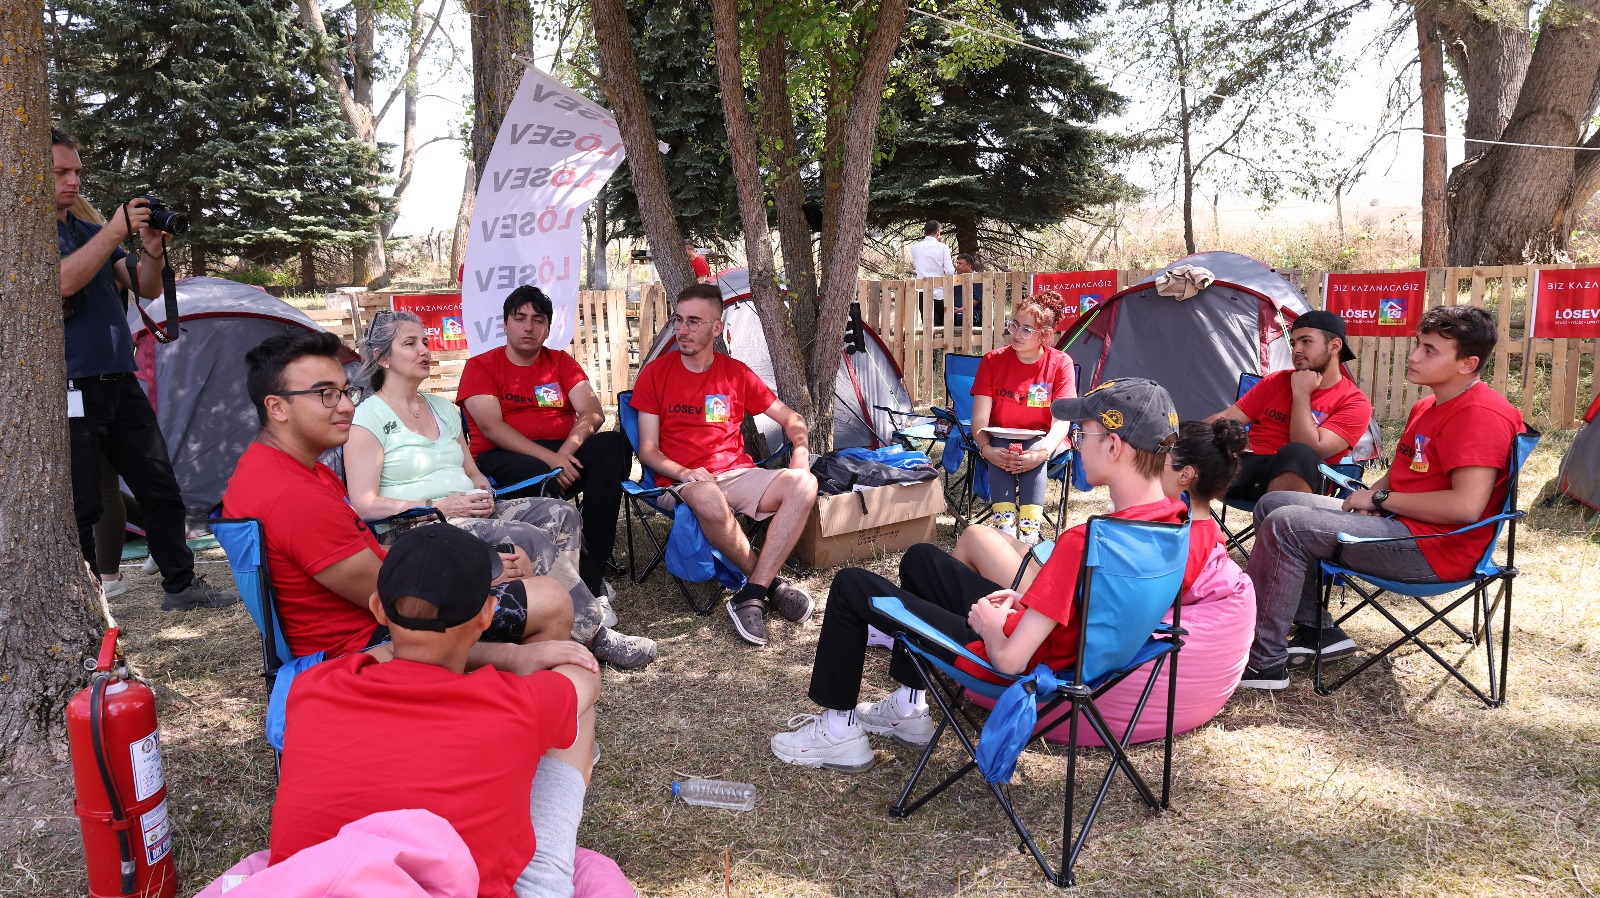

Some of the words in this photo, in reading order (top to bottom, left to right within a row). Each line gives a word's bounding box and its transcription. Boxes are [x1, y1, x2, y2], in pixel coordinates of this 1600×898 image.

[1351, 283, 1420, 292] KAZANACAĞIZ
[1340, 308, 1377, 319] LÖSEV
[1555, 308, 1600, 319] LÖSEV
[424, 327, 441, 336] SEV
[668, 403, 703, 415] LÖSEV
[1264, 407, 1291, 424] LÖSE
